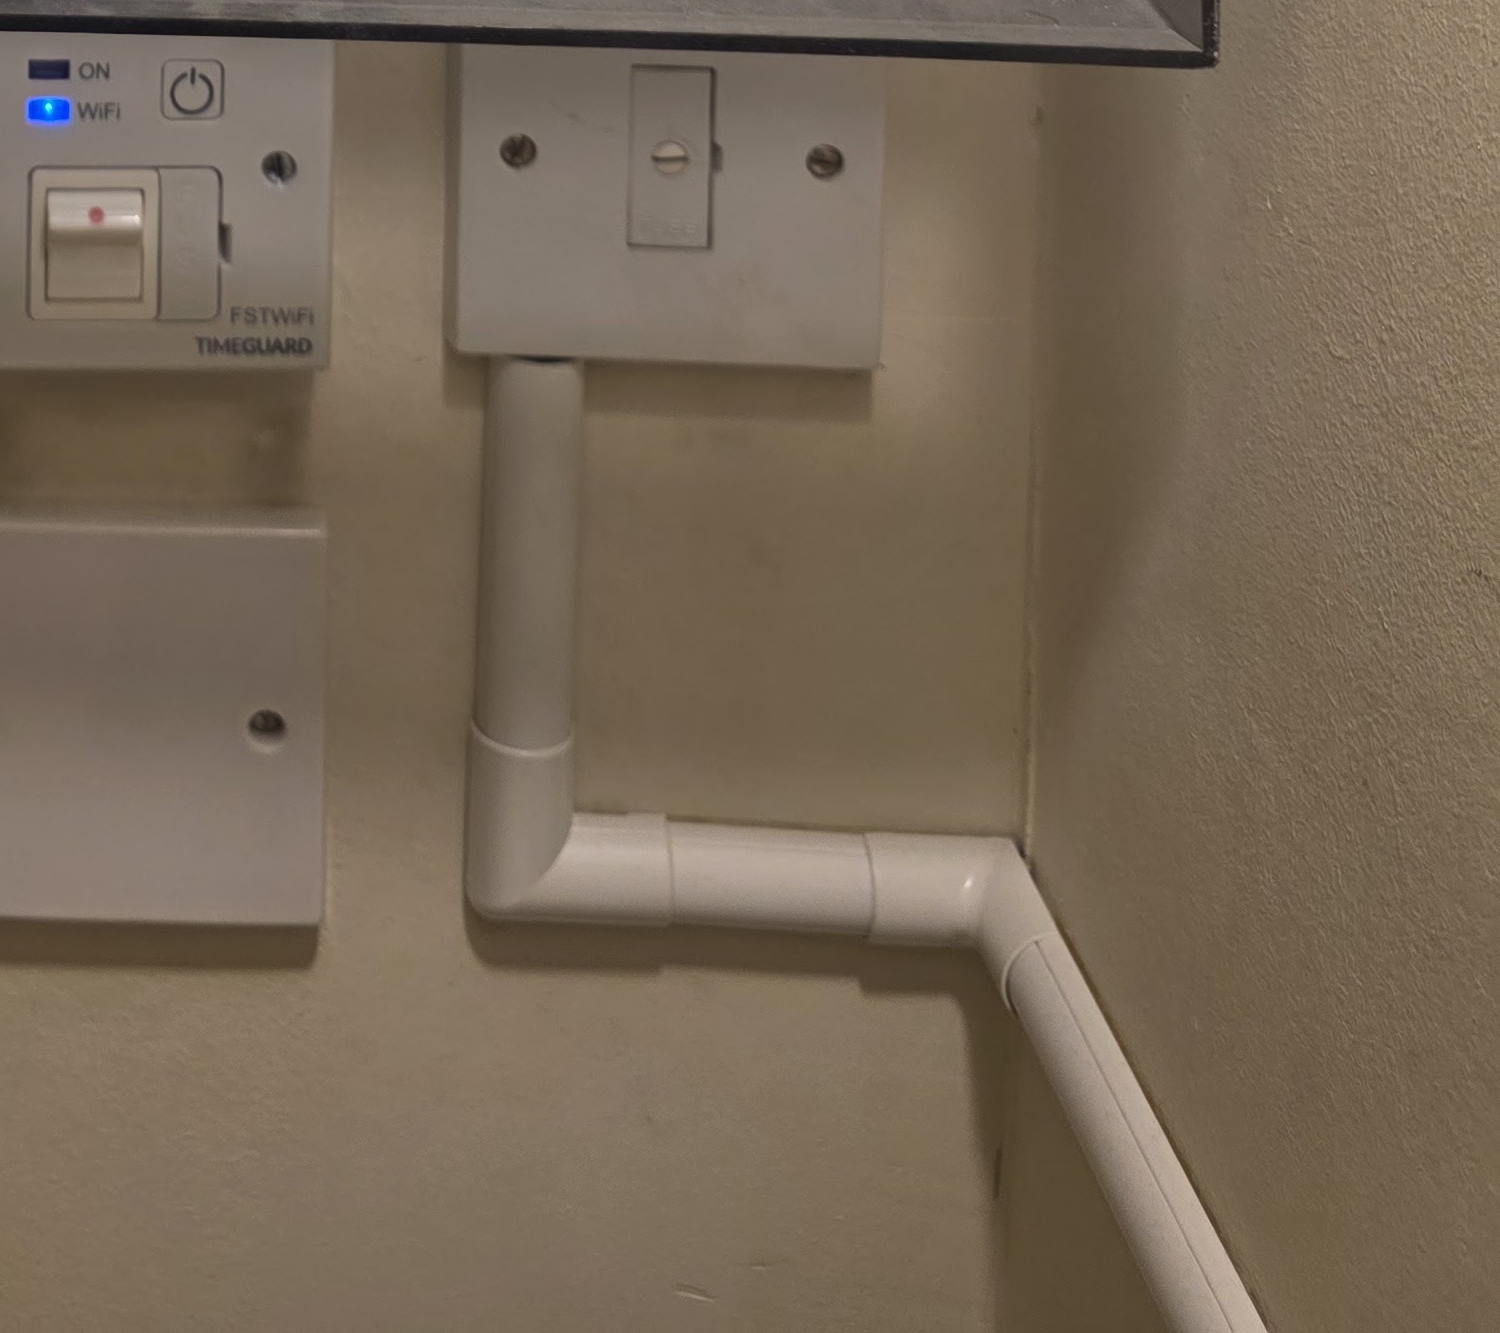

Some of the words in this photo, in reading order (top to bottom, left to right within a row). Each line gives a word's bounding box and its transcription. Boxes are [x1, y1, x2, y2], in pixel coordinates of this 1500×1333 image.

[78, 63, 111, 80] ON
[77, 102, 121, 120] WiFi
[194, 336, 314, 355] TIMEGUARD
